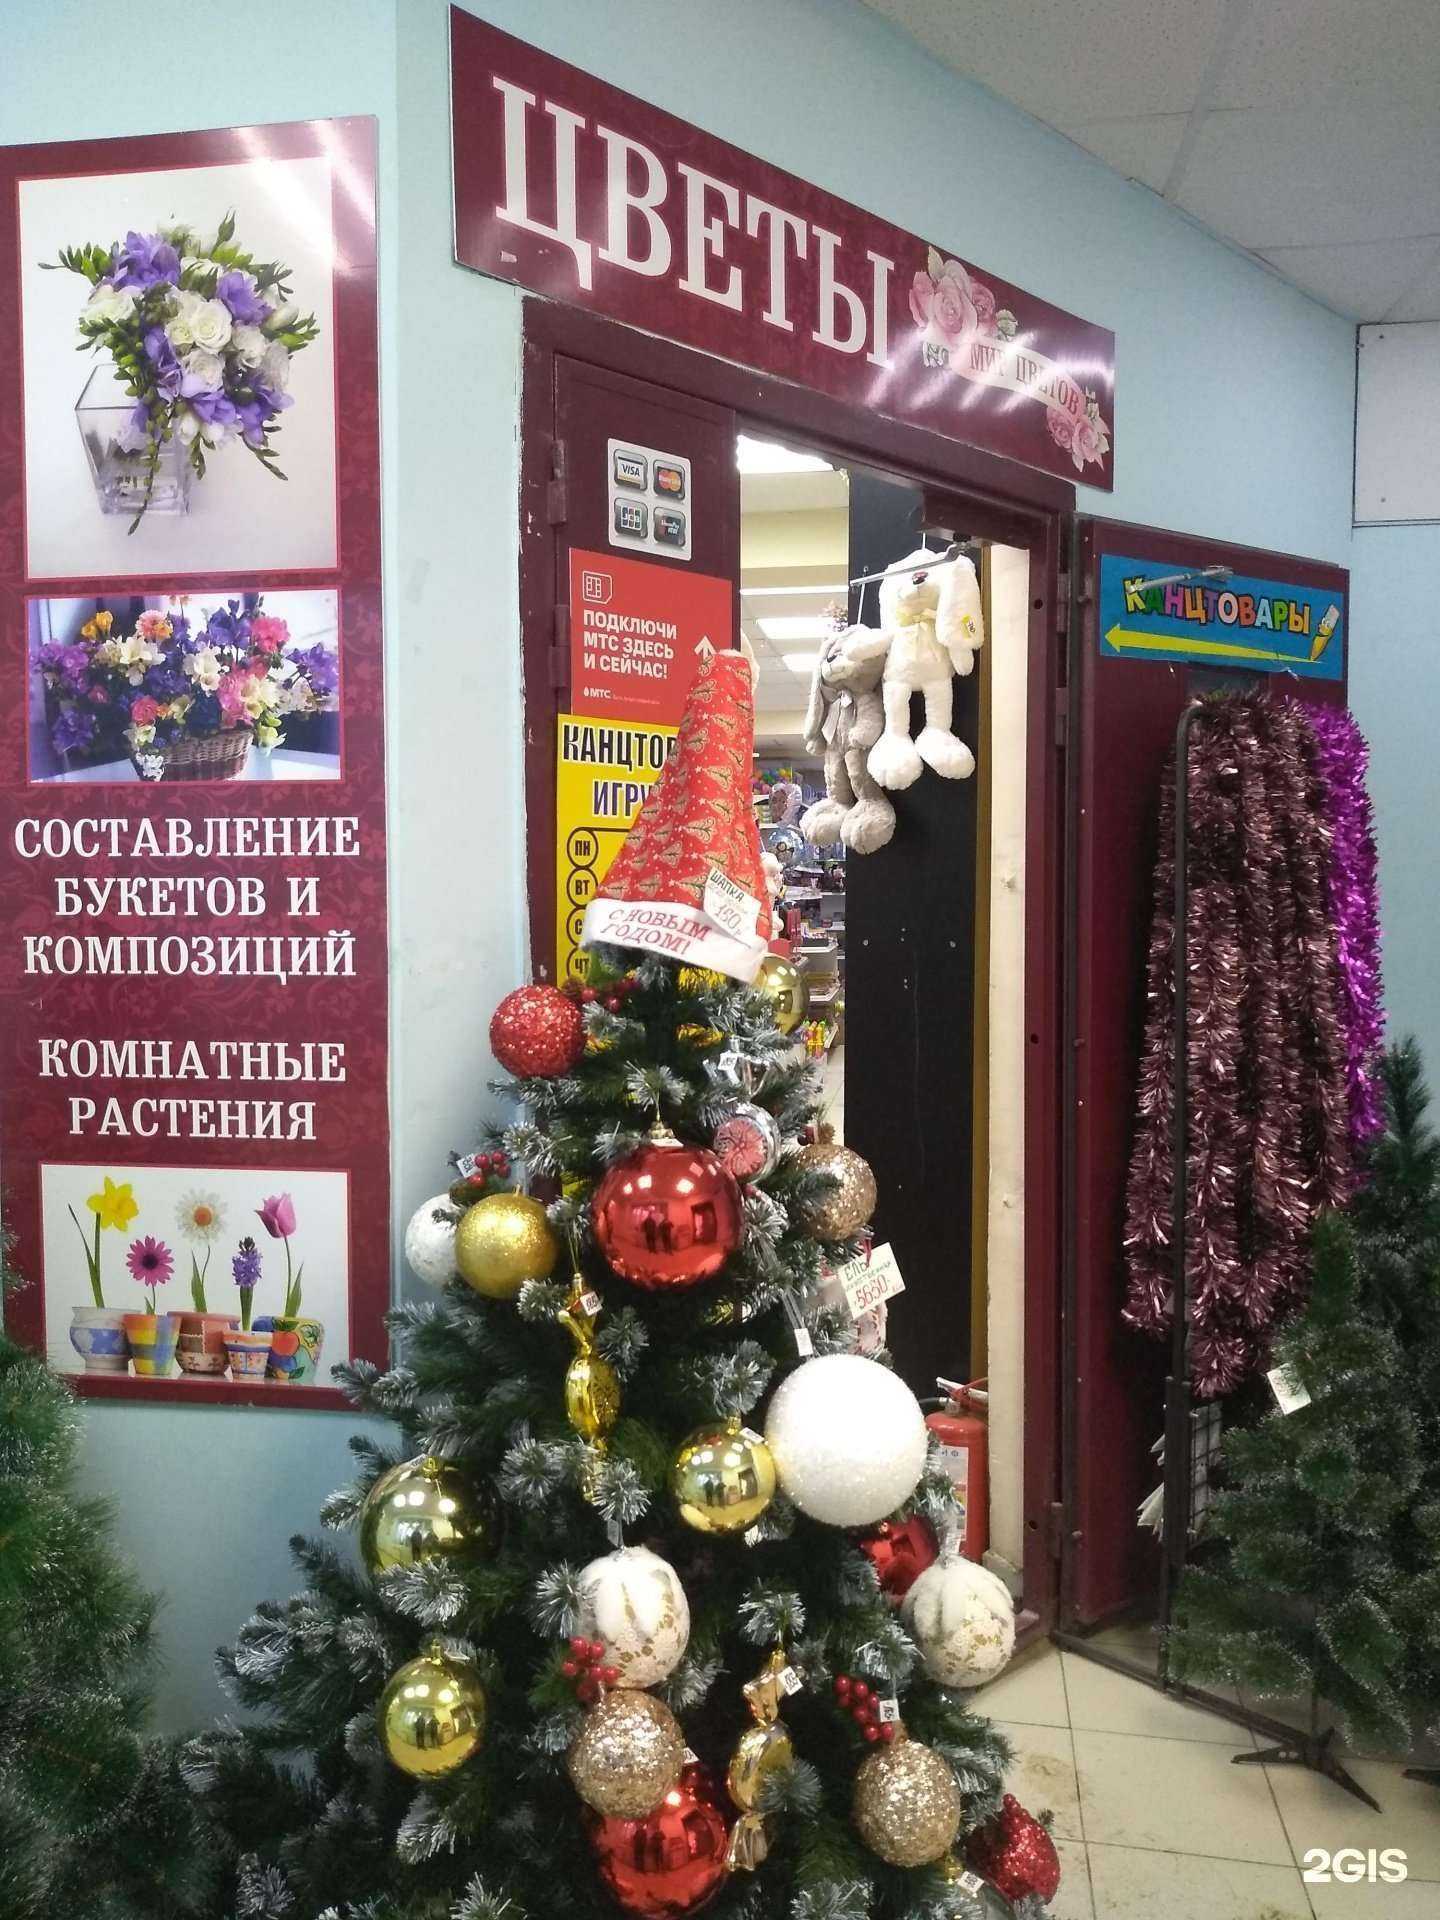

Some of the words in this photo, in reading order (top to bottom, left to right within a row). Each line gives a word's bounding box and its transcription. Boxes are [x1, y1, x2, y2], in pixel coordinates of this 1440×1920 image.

[492, 76, 895, 370] ЦВЕТЫ
[621, 463, 641, 477] VISA
[583, 609, 678, 640] ПОДКЛЮЧИ
[583, 631, 619, 652] МТС
[622, 637, 675, 659] ЗДЕСЬ
[583, 652, 596, 670] И
[599, 653, 668, 680] СЕЙЧАС!
[589, 687, 611, 699] МТС
[14, 816, 360, 858] СОСТАВЛЕНИЕ
[574, 840, 591, 856] ПН
[54, 876, 267, 917] БУКЕТОВ
[286, 876, 321, 917] И
[574, 879, 590, 896] ВТ
[710, 870, 745, 902] ШАПКА
[600, 923, 692, 955] ГОДОМ!
[623, 909, 712, 941] НОВЫМ
[22, 929, 357, 985] КОМПОЗИЦИЙ
[38, 1038, 347, 1082] КОМНАТНЫЕ
[68, 1097, 317, 1140] РАСТЕНИЯ
